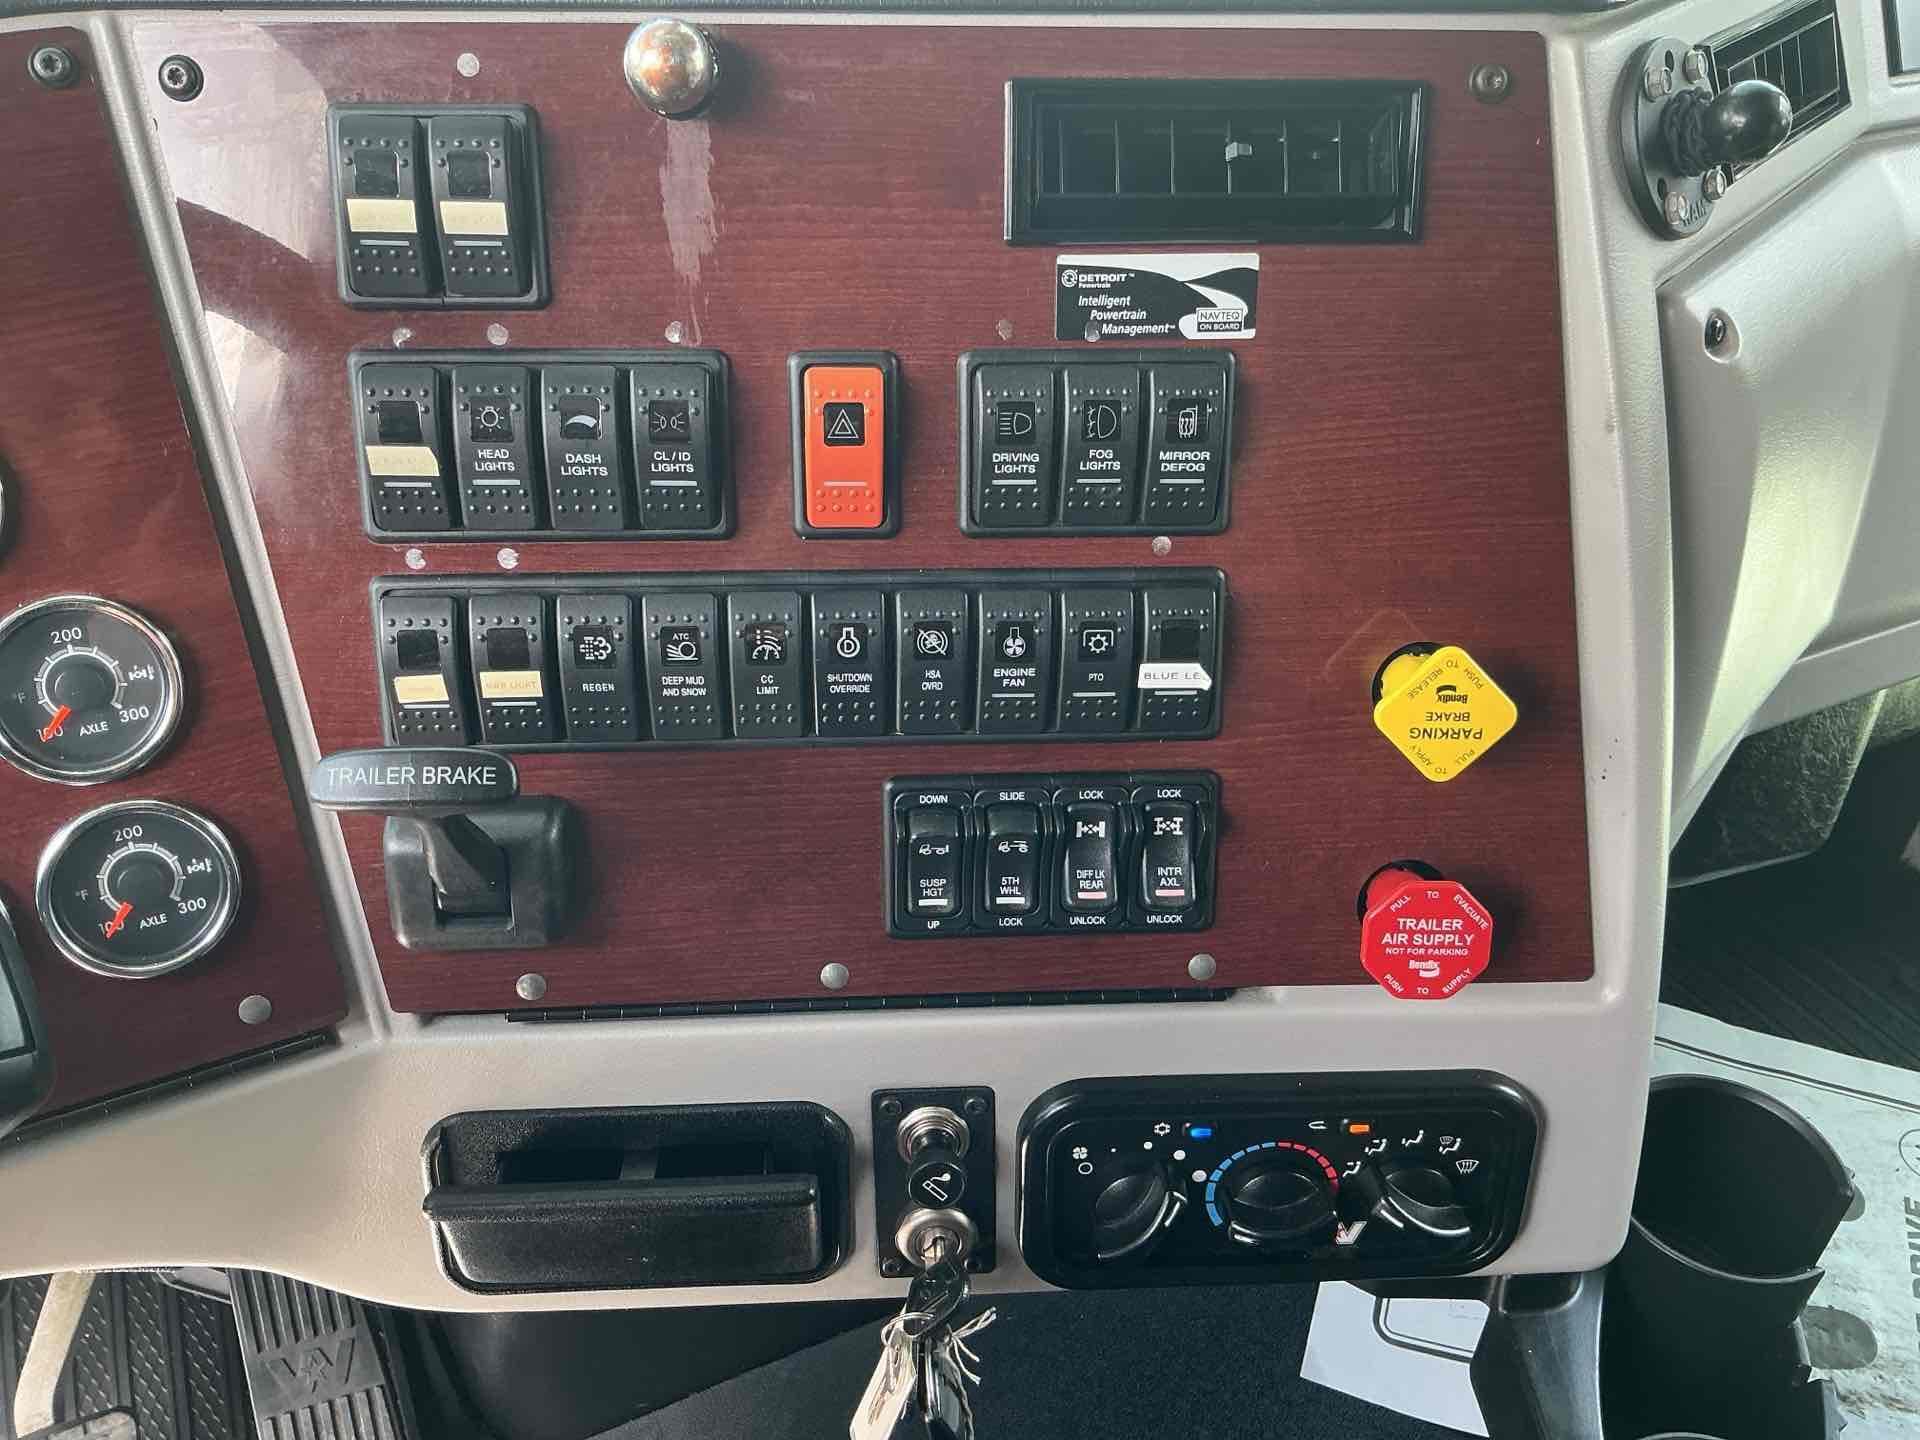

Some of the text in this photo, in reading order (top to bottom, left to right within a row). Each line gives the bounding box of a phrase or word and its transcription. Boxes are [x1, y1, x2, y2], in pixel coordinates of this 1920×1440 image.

[1078, 273, 1127, 283] DETROIT
[1078, 295, 1131, 308] Intelligent
[1090, 309, 1147, 321] Powertrain
[1199, 311, 1241, 322] NAVTEQ
[1199, 323, 1240, 331] ON BOARD
[478, 450, 509, 459] HEAD
[565, 454, 601, 464] DASH
[653, 451, 669, 462] CL
[678, 451, 691, 462] ID
[992, 452, 1039, 463] DRIVING
[1089, 449, 1113, 459] FOG
[1159, 450, 1210, 461] MIRROR
[475, 461, 515, 472] LIGHTS
[650, 463, 694, 473] LIGHTS
[994, 464, 1036, 474] LIGHTS
[1079, 460, 1121, 470] LIGHTS
[1161, 462, 1206, 472] DEFOG
[560, 465, 608, 476] LIGHTS
[49, 627, 82, 644] 200
[672, 632, 689, 640] ATC
[1445, 658, 1460, 669] TO
[827, 673, 873, 683] SHUTDOWN
[925, 669, 942, 679] HSA
[993, 668, 1036, 678] ENGINE
[1088, 673, 1104, 682] PTO
[1144, 672, 1178, 680] BLUE
[662, 676, 705, 685] DEEP MUD
[760, 675, 774, 684] CC
[1002, 679, 1025, 688] FAN
[1407, 668, 1444, 699] RELEASE
[1463, 668, 1484, 690] PUSH
[582, 683, 615, 693] REGEN
[756, 686, 779, 695] LIMIT
[829, 685, 870, 694] OVERRIDE
[921, 681, 943, 691] OVRD
[662, 687, 707, 697] AND SNOW
[1436, 693, 1469, 704] Bendix
[119, 706, 150, 723] 300
[1425, 712, 1471, 722] BRAKE
[79, 721, 109, 737] AXLE
[1409, 727, 1483, 740] PARKING
[1455, 749, 1475, 766] PULL
[1434, 766, 1448, 775] TO
[327, 767, 497, 786] TRAILER BRAKE
[999, 791, 1025, 801] SLIDE
[1079, 790, 1104, 800] LOCK
[1157, 788, 1181, 798] LOCK
[919, 794, 948, 804] DOWN
[114, 825, 144, 842] 200
[1076, 869, 1105, 879] DIFF LK
[1157, 866, 1182, 876] INTR
[919, 879, 947, 888] SUSP
[1001, 876, 1020, 886] 5TH
[1079, 879, 1104, 889] REAR
[1159, 876, 1180, 887] AXL
[922, 888, 943, 897] HGT
[1000, 886, 1021, 895] WHL
[1427, 890, 1440, 899] TO
[177, 897, 208, 914] 300
[1390, 895, 1411, 912] PULL
[1453, 893, 1489, 930] EVACUATE
[139, 913, 168, 929] AXLE
[998, 917, 1023, 927] LOCK
[1069, 915, 1106, 926] UNLOCK
[1146, 914, 1183, 924] UNLOCK
[927, 920, 941, 930] UP
[1397, 918, 1464, 931] TRAILER
[1381, 933, 1474, 946] AIR SUPPLY
[1427, 948, 1468, 956] PARKING
[1408, 959, 1440, 970] Bendix
[1383, 973, 1405, 994] PUSH
[1442, 967, 1473, 994] SUPPLY
[1416, 986, 1430, 995] TO
